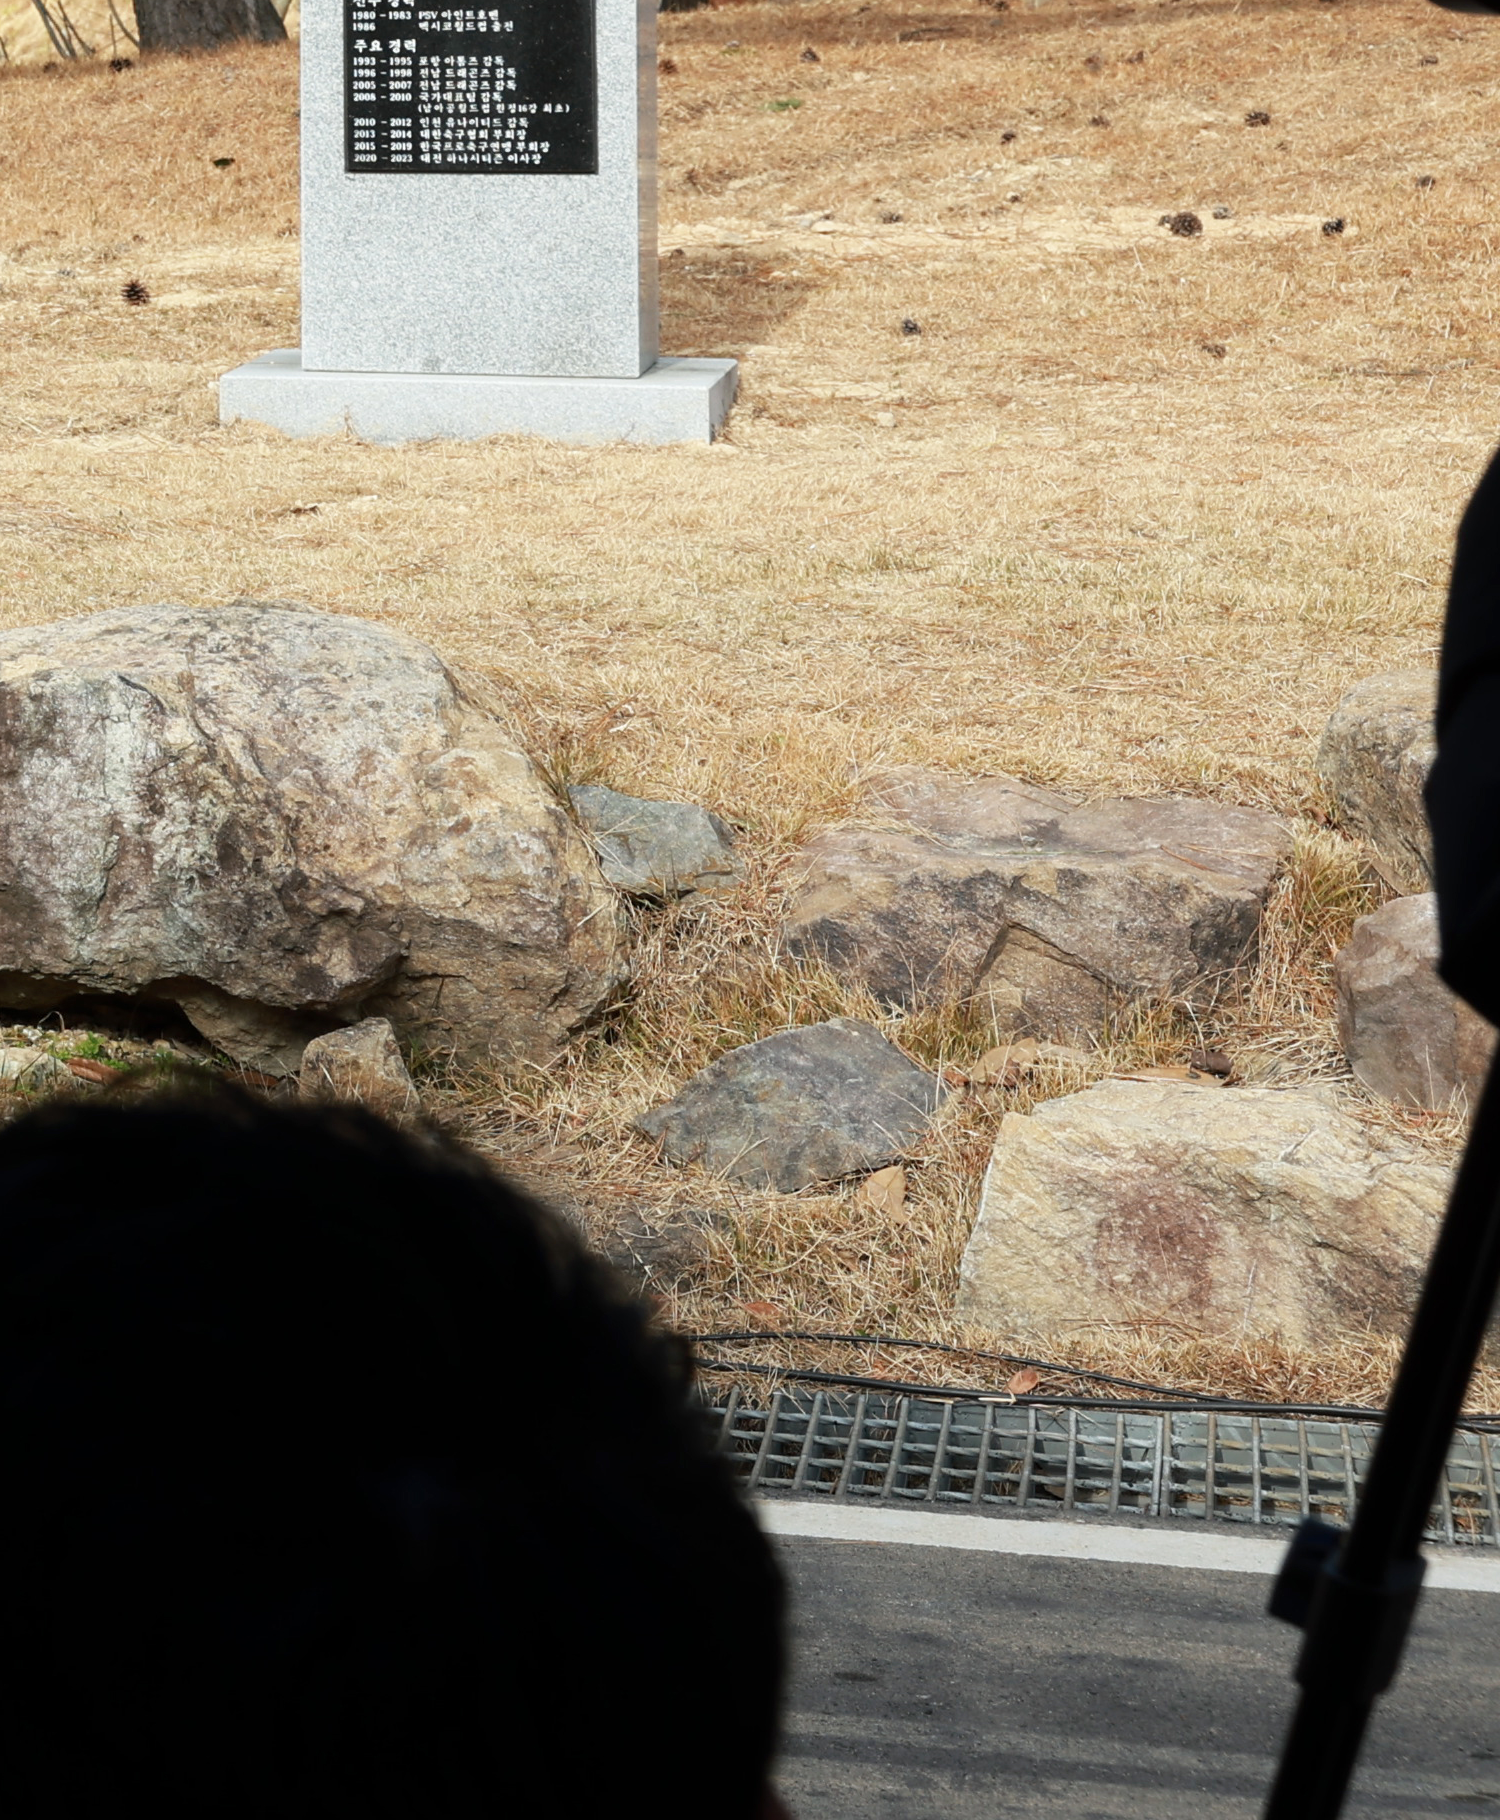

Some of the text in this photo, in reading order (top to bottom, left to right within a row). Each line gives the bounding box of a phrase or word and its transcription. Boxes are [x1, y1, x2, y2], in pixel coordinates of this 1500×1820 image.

[353, 11, 376, 20] 1980
[389, 11, 411, 20] 1983
[419, 11, 438, 19] PSV
[353, 23, 375, 31] 1986
[354, 39, 416, 53] 주요 경력
[354, 57, 376, 65] 1993
[390, 57, 412, 65] 1995
[419, 56, 440, 67] 포항
[483, 56, 504, 67] 감독
[353, 81, 376, 89] 2005
[389, 81, 412, 89] 2007
[420, 80, 441, 91] 전남
[495, 80, 516, 91] 감독
[354, 118, 376, 126] 2010
[390, 118, 412, 127] 2012
[420, 117, 441, 128] 인천
[508, 117, 528, 128] 감독
[354, 154, 377, 162] 2020
[391, 154, 413, 162] 2023
[420, 153, 442, 164] 대전
